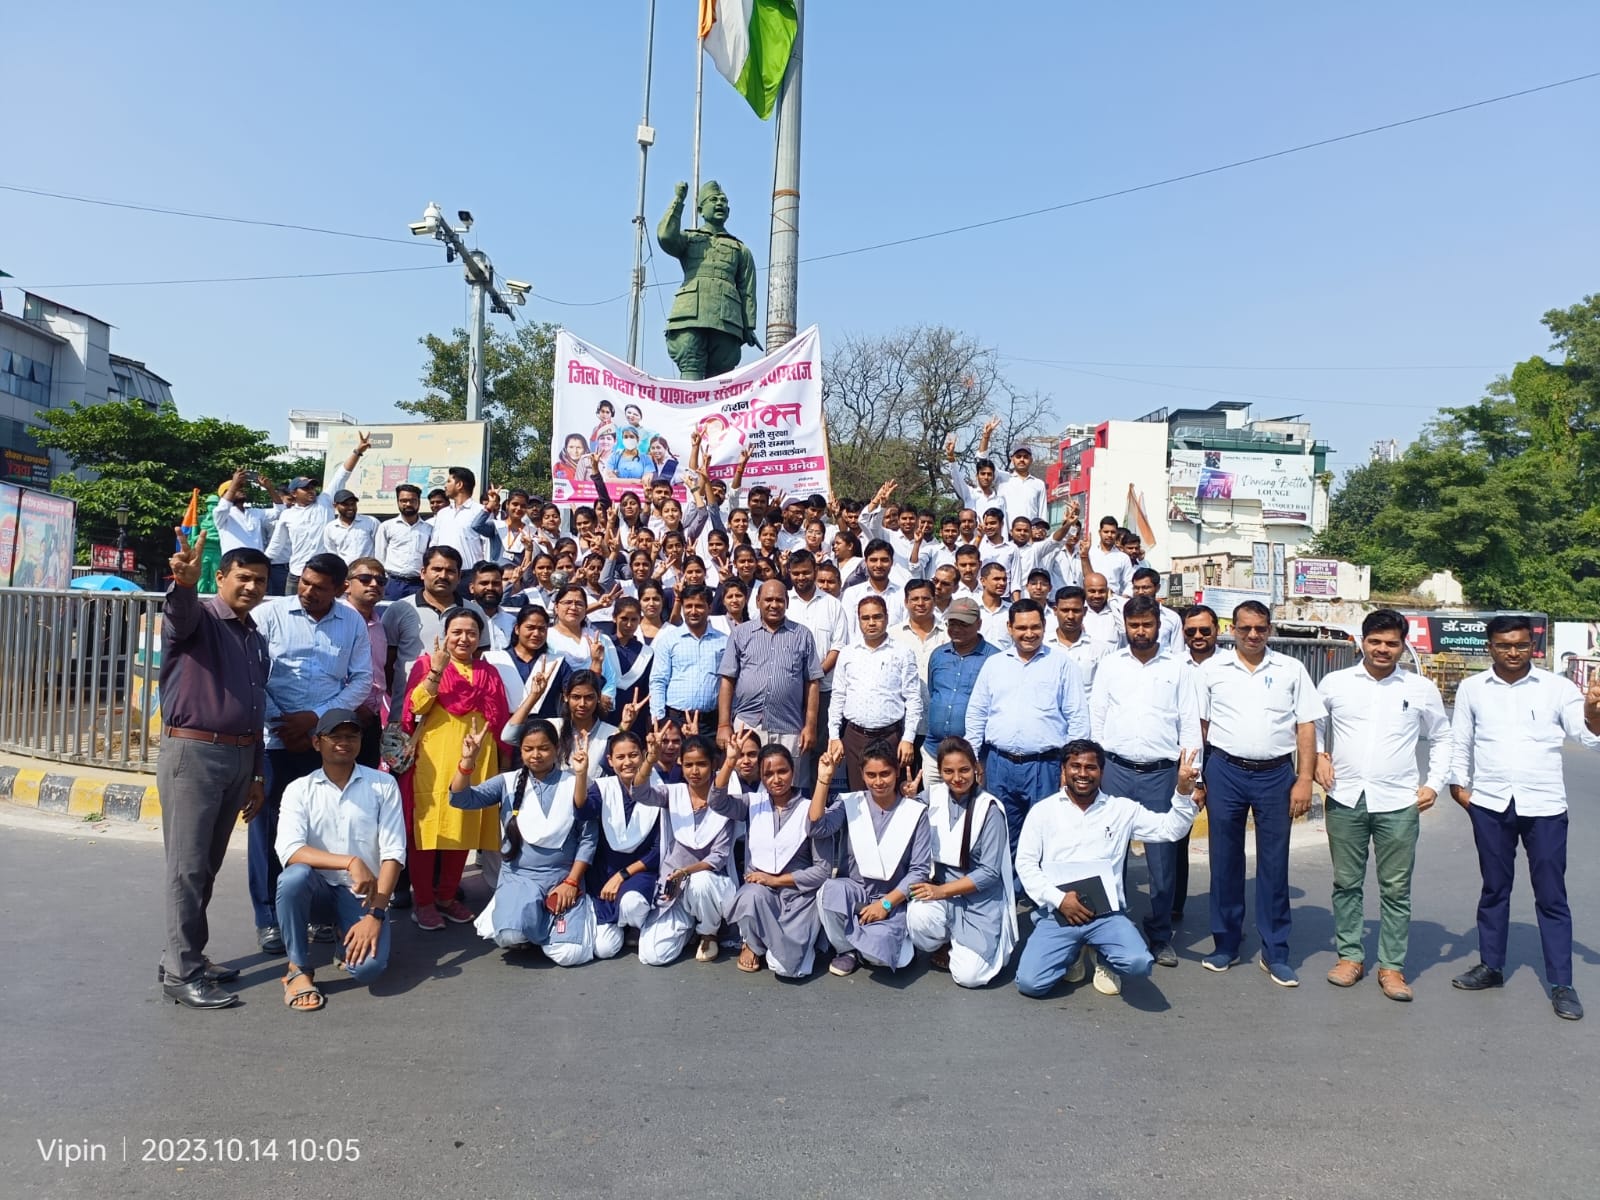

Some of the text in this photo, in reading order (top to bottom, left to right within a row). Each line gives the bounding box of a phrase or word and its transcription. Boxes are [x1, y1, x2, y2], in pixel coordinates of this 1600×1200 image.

[568, 359, 600, 385] जिला
[602, 369, 635, 397] शिक्षा
[637, 384, 657, 401] एवं
[729, 398, 802, 445] शक्ति
[748, 429, 789, 441] नारी सुरक्षा
[768, 439, 795, 448] सम्मान
[710, 466, 734, 477] नारी
[762, 463, 784, 474] रूप
[788, 460, 818, 471] अनेक
[1258, 489, 1290, 497] LOUNGE
